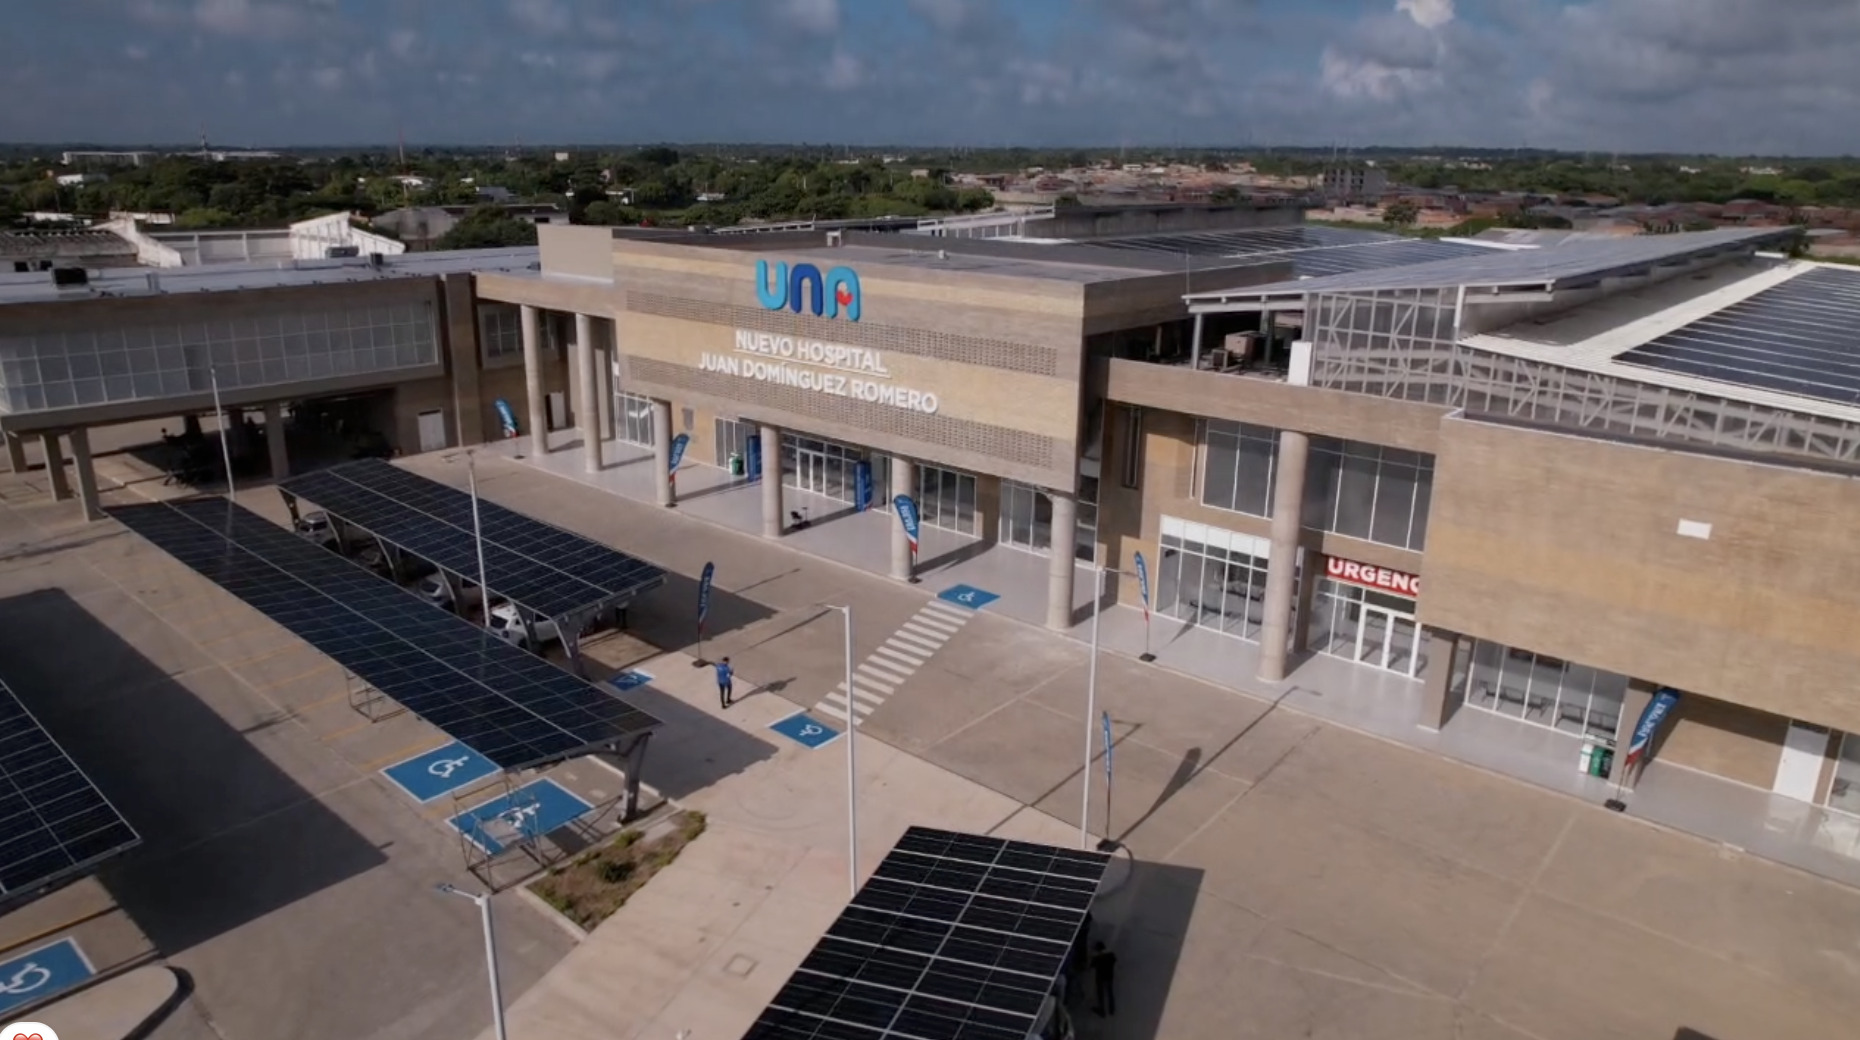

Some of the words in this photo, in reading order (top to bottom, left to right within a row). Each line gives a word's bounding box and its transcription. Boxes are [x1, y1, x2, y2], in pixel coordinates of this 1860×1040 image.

[735, 330, 793, 357] NUEVO
[797, 341, 888, 373] HOSPITAL
[698, 352, 739, 375] JUAN
[742, 360, 847, 396] DOMÍNGUEZ
[851, 379, 939, 414] ROMERO
